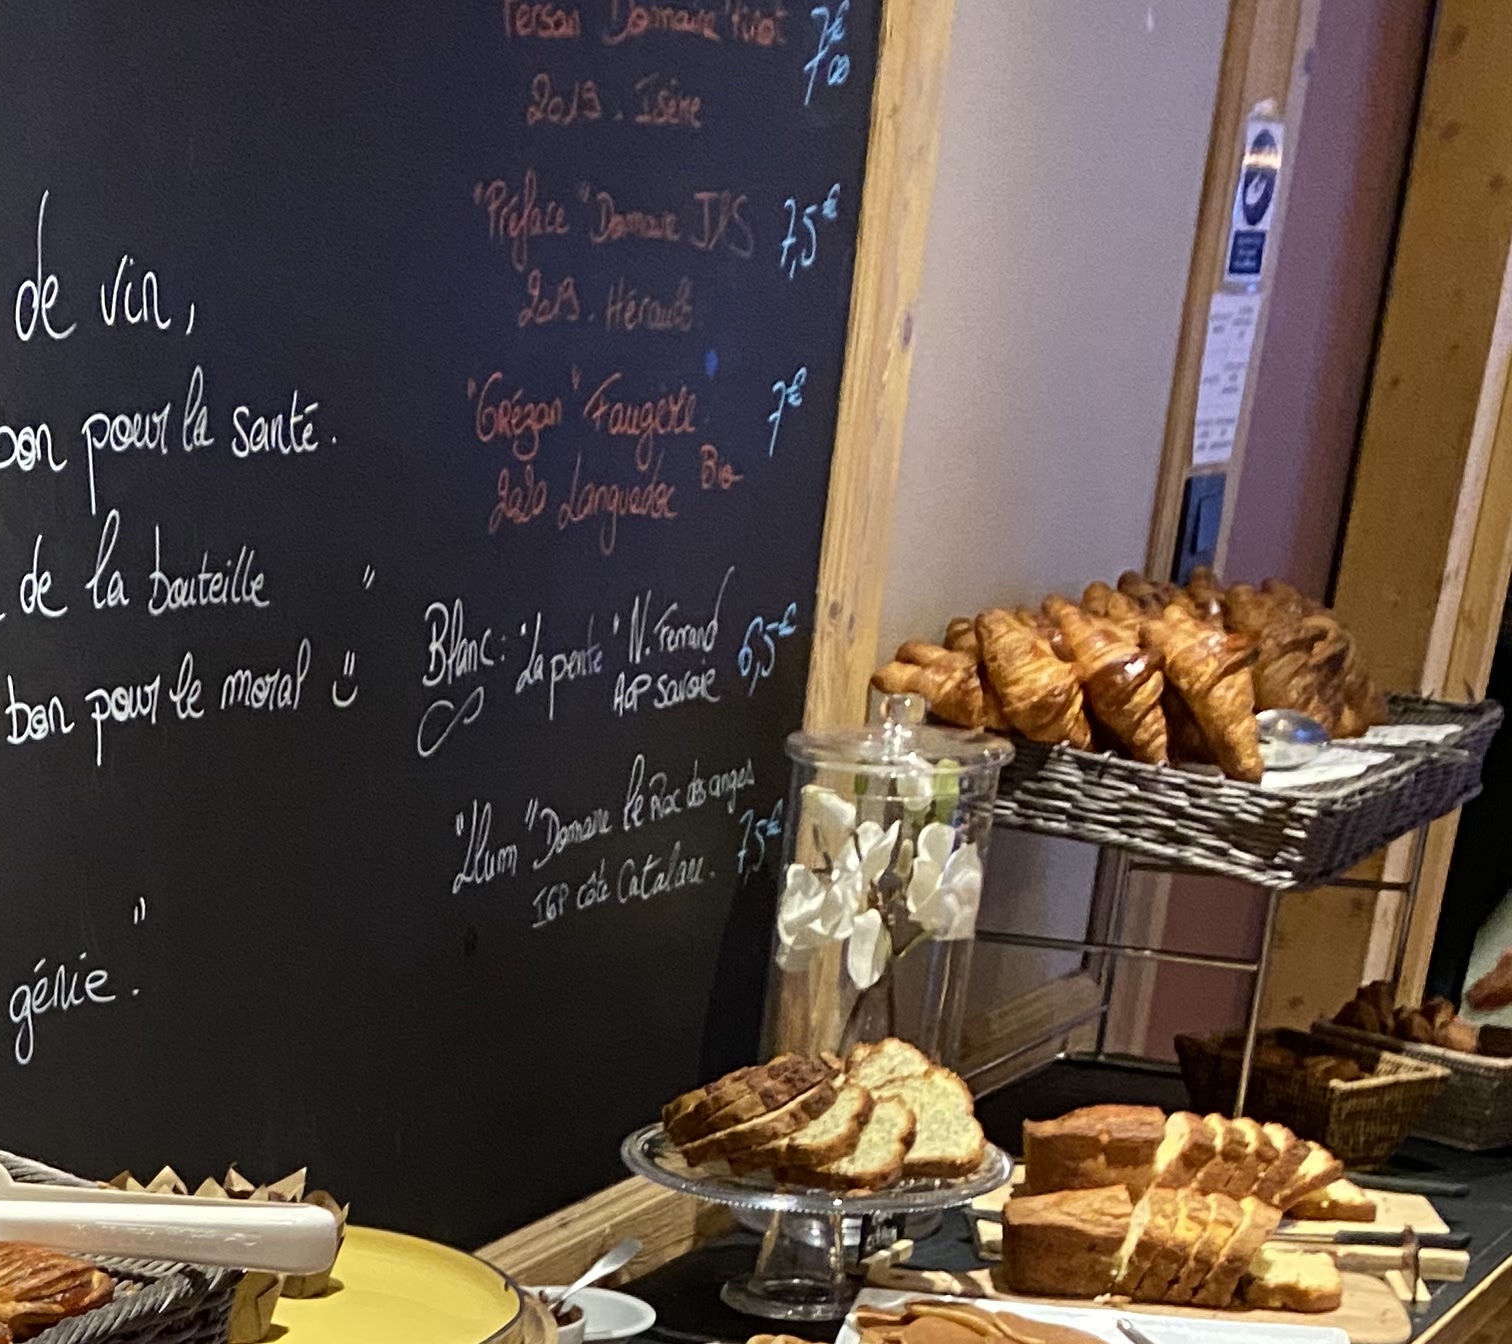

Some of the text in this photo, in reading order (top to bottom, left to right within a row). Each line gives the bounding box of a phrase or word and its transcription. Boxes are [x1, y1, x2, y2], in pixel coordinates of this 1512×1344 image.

[14, 190, 77, 341] de
[100, 254, 195, 336] vin,
[82, 400, 171, 516] pour
[181, 364, 215, 455] la
[231, 388, 339, 460] santé.
[19, 534, 68, 618] de
[85, 508, 130, 610] la
[147, 523, 272, 617] bouteille
[6, 674, 75, 746] bon
[85, 672, 162, 767] pour
[169, 650, 205, 720] le
[221, 637, 312, 709] moral
